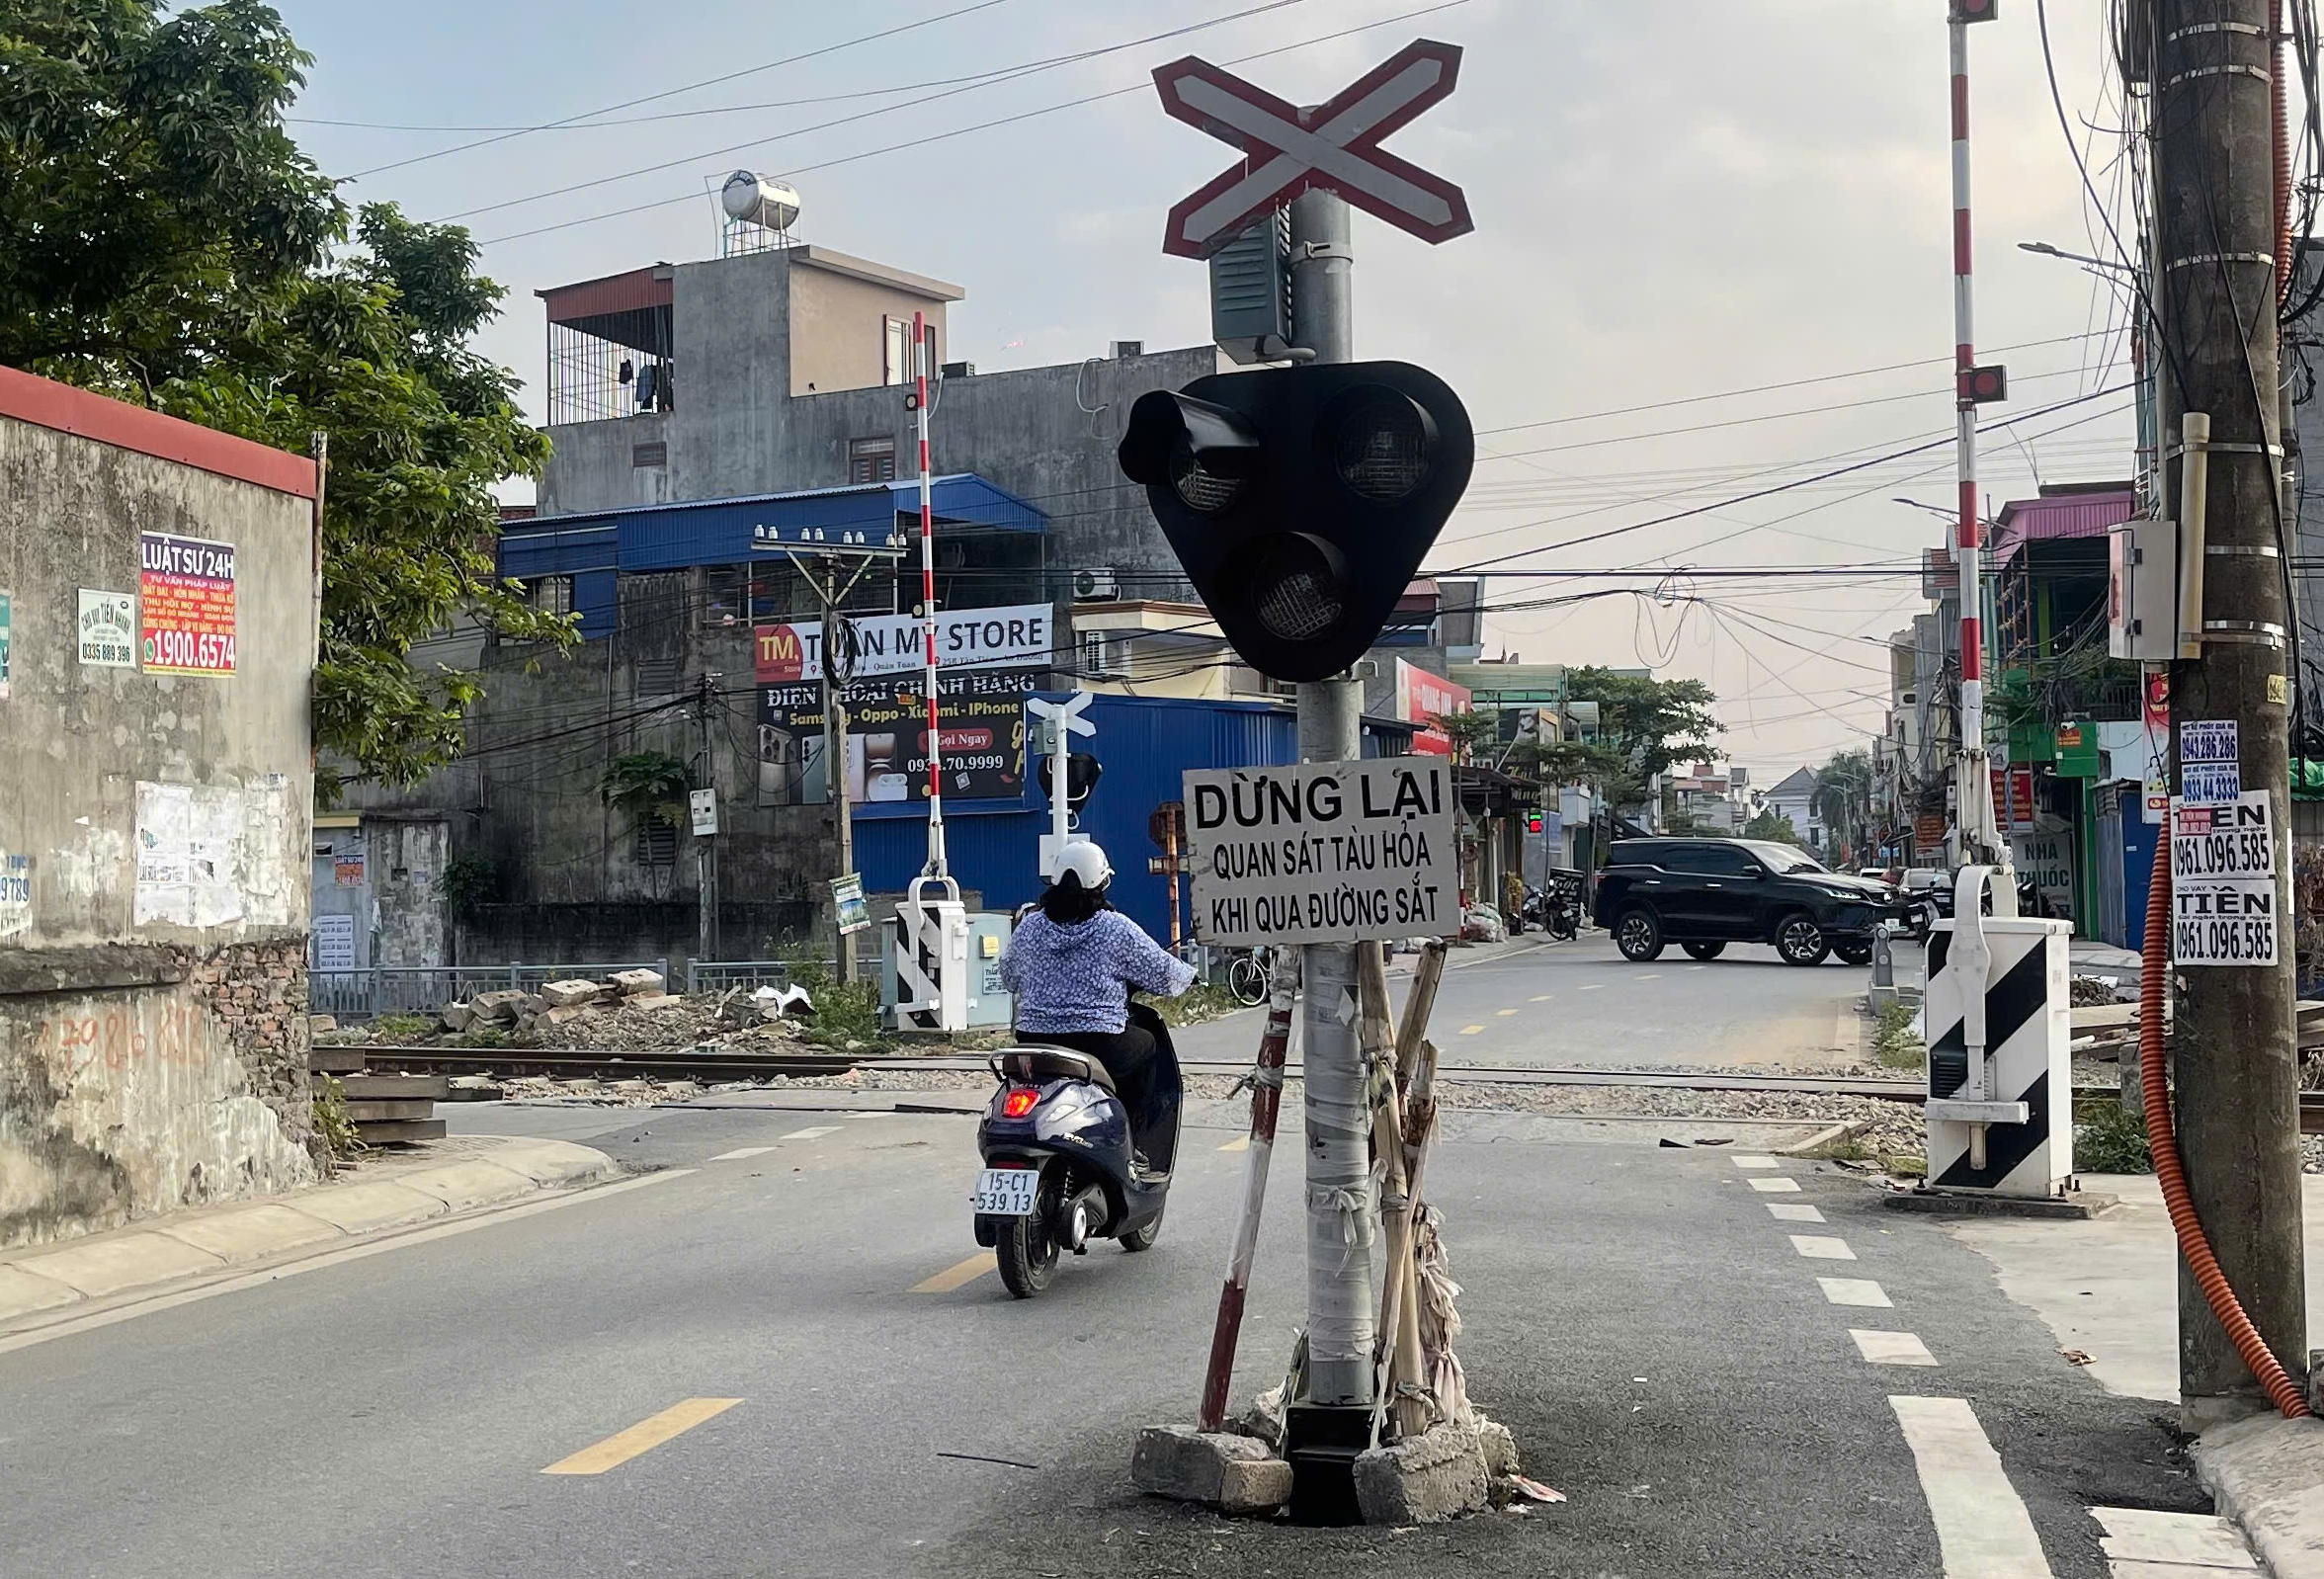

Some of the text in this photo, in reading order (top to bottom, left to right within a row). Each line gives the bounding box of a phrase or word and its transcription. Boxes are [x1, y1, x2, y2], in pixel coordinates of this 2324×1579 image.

[141, 538, 234, 579] LUẬT SƯ 24H
[155, 629, 235, 669] 1900.6574
[804, 621, 884, 661] TN
[948, 618, 1043, 651] STORE
[767, 686, 817, 709] ĐIỆN
[838, 682, 888, 705] HOẠI
[893, 677, 966, 698] CHNH
[789, 711, 852, 726] Samsg
[861, 707, 899, 723] Oppo
[968, 702, 1020, 715] IPhone
[958, 733, 988, 746] Ngay
[907, 755, 1004, 772] 093.70.9999
[1194, 769, 1442, 829] DỪNG LẠI
[1213, 819, 1432, 881] QUAN SÁT TÀU HỎA
[2175, 833, 2270, 877] 0961.096.585
[1211, 872, 1439, 934] KHI QUA ĐƯỜNG SẮT
[2177, 921, 2273, 959] 0961.096.585
[989, 1172, 1028, 1192] 15-C1
[977, 1193, 1032, 1211] 539.13
